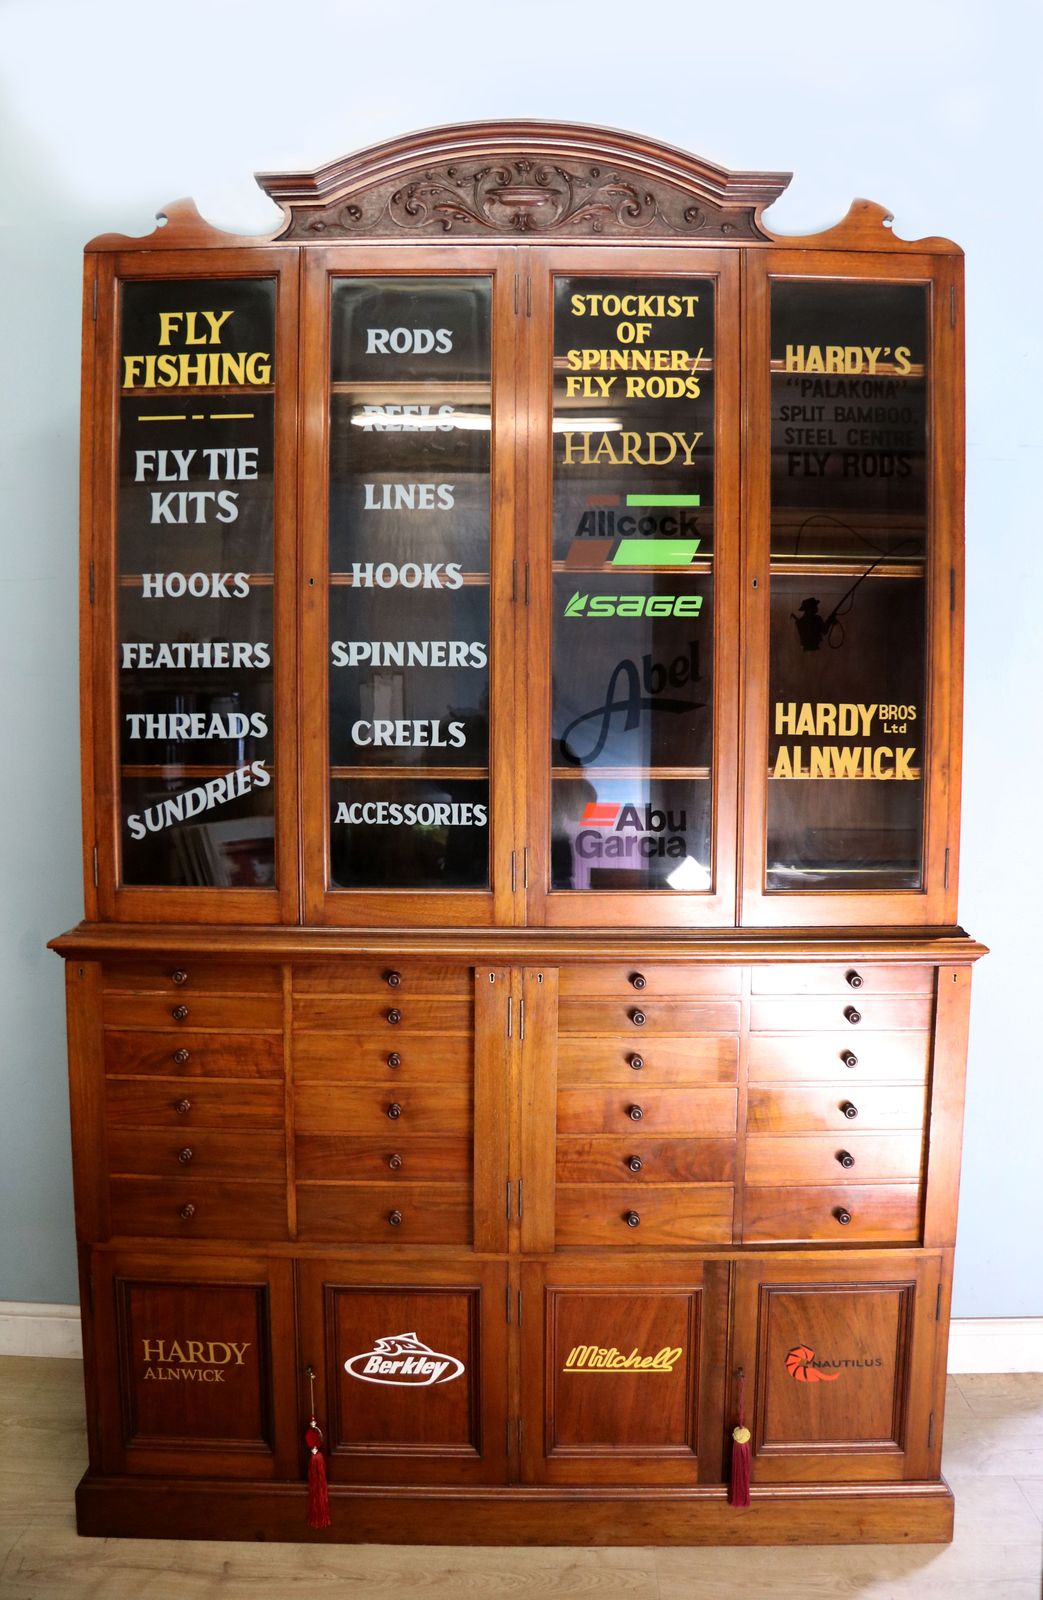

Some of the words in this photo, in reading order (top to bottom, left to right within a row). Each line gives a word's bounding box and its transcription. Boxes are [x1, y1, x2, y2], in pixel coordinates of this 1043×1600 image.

[571, 294, 699, 318] STOCKIST
[158, 310, 234, 346] FLY
[365, 327, 453, 354] RODS
[616, 321, 652, 344] OF
[123, 352, 272, 388] FISHING
[567, 347, 704, 375] SPINNER/
[786, 344, 912, 375] HARDY'S
[566, 376, 617, 398] FLY
[626, 376, 701, 399] RODS
[779, 405, 825, 422] SPLIT
[562, 431, 704, 466] HARDY
[784, 427, 837, 446] STEEL
[847, 428, 915, 447] CENTRE
[134, 449, 197, 482] FLY
[203, 447, 259, 481] TIE
[788, 452, 831, 477] FLY
[842, 452, 912, 478] RODS
[150, 490, 239, 524] KITS
[364, 483, 455, 511] LINES
[575, 510, 700, 537] Allcock
[142, 572, 250, 598] HOOKS
[351, 562, 464, 590] HOOKS
[122, 641, 271, 669] FEATHERS
[331, 640, 487, 669] SPINNERS
[560, 639, 707, 765] Abel
[126, 711, 268, 739] THREADS
[351, 719, 466, 748] CREELS
[775, 702, 878, 737] HARDY
[878, 704, 917, 720] BROS
[883, 722, 907, 734] Ltd
[773, 745, 917, 780] ALNWICK
[127, 759, 271, 840] SUNDRIES
[334, 801, 487, 827] ACCESSORIES
[615, 802, 687, 832] Abu
[575, 829, 687, 859] Garcia
[142, 1338, 251, 1366] HARDY
[565, 1345, 682, 1370] Mitchell
[811, 1358, 882, 1368] NAUTILUS
[143, 1367, 226, 1383] ALNWICK
[363, 1355, 449, 1379] Berkley
